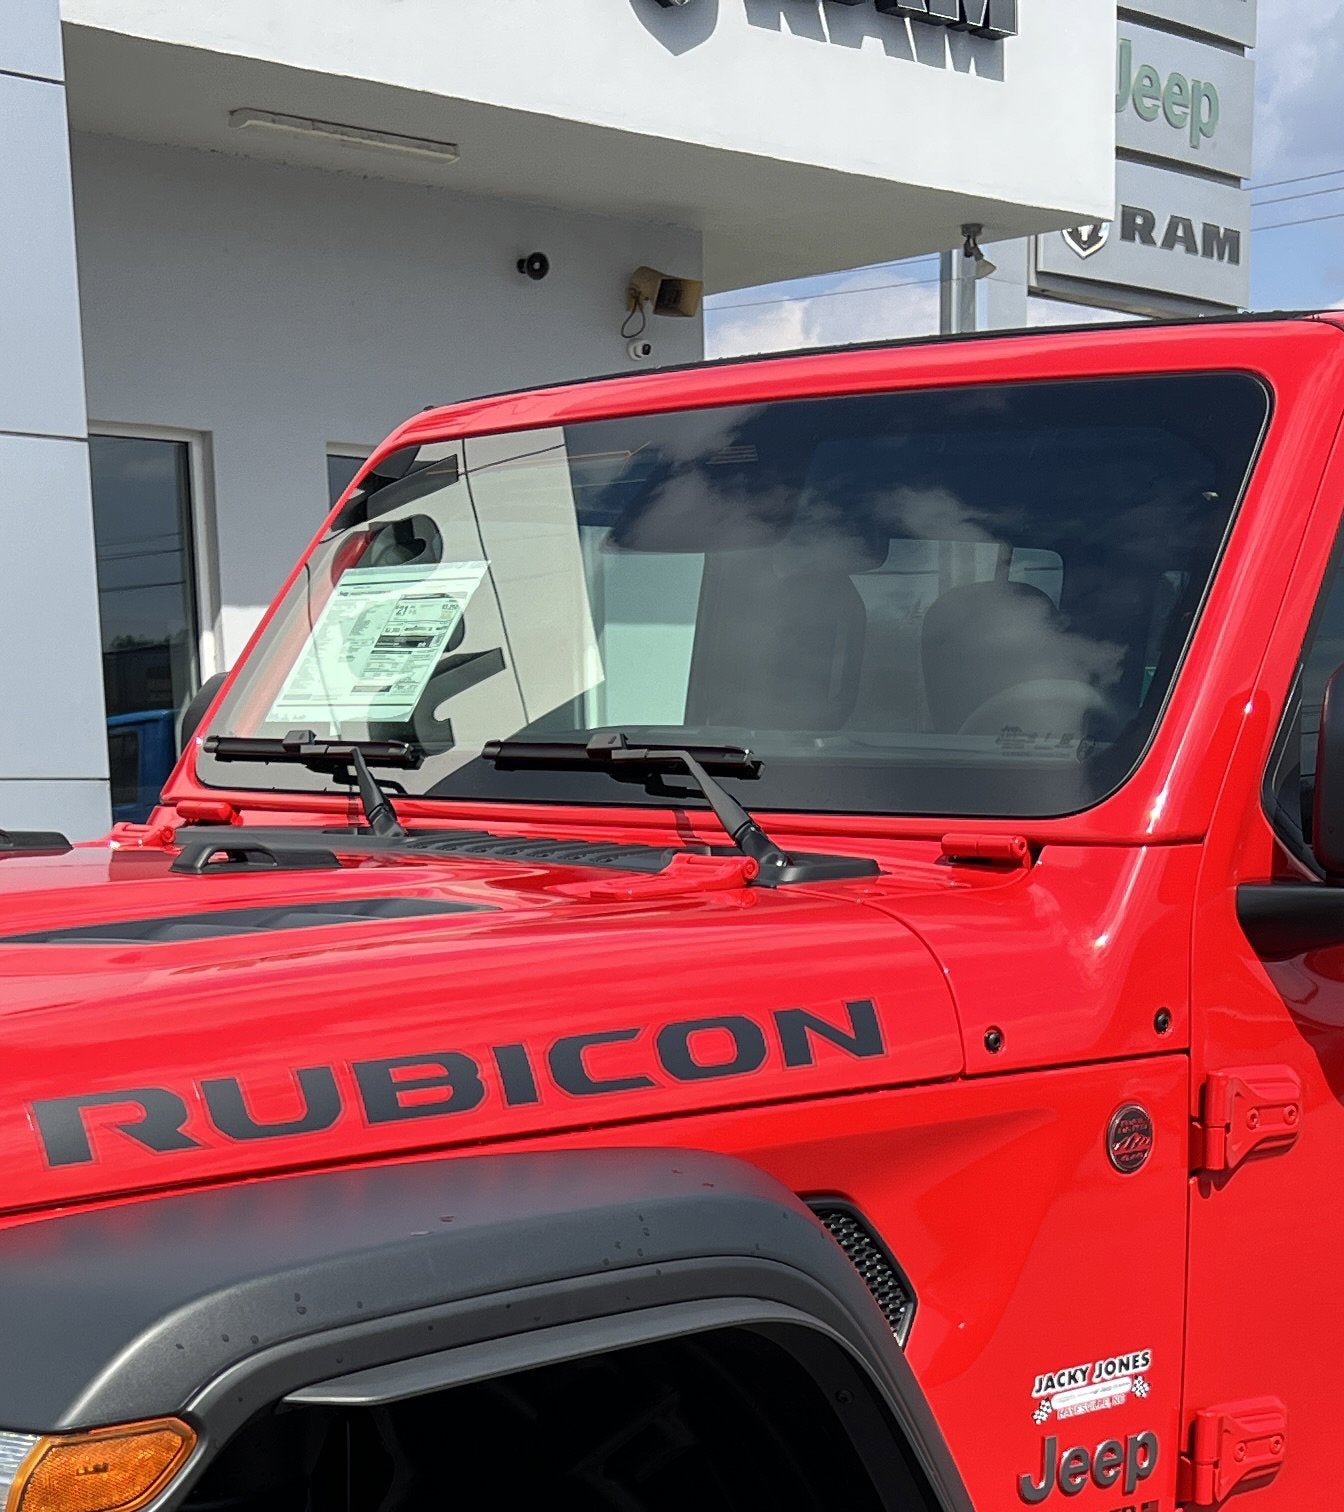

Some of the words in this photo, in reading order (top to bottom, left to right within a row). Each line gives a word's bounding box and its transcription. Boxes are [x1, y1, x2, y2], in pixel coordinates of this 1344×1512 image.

[1115, 38, 1219, 149] Jeep
[1120, 204, 1241, 266] RAM
[27, 999, 886, 1167] RUBICON
[1035, 1366, 1090, 1393] JACKY
[1096, 1351, 1151, 1379] JONES
[1017, 1431, 1160, 1505] Jeep
